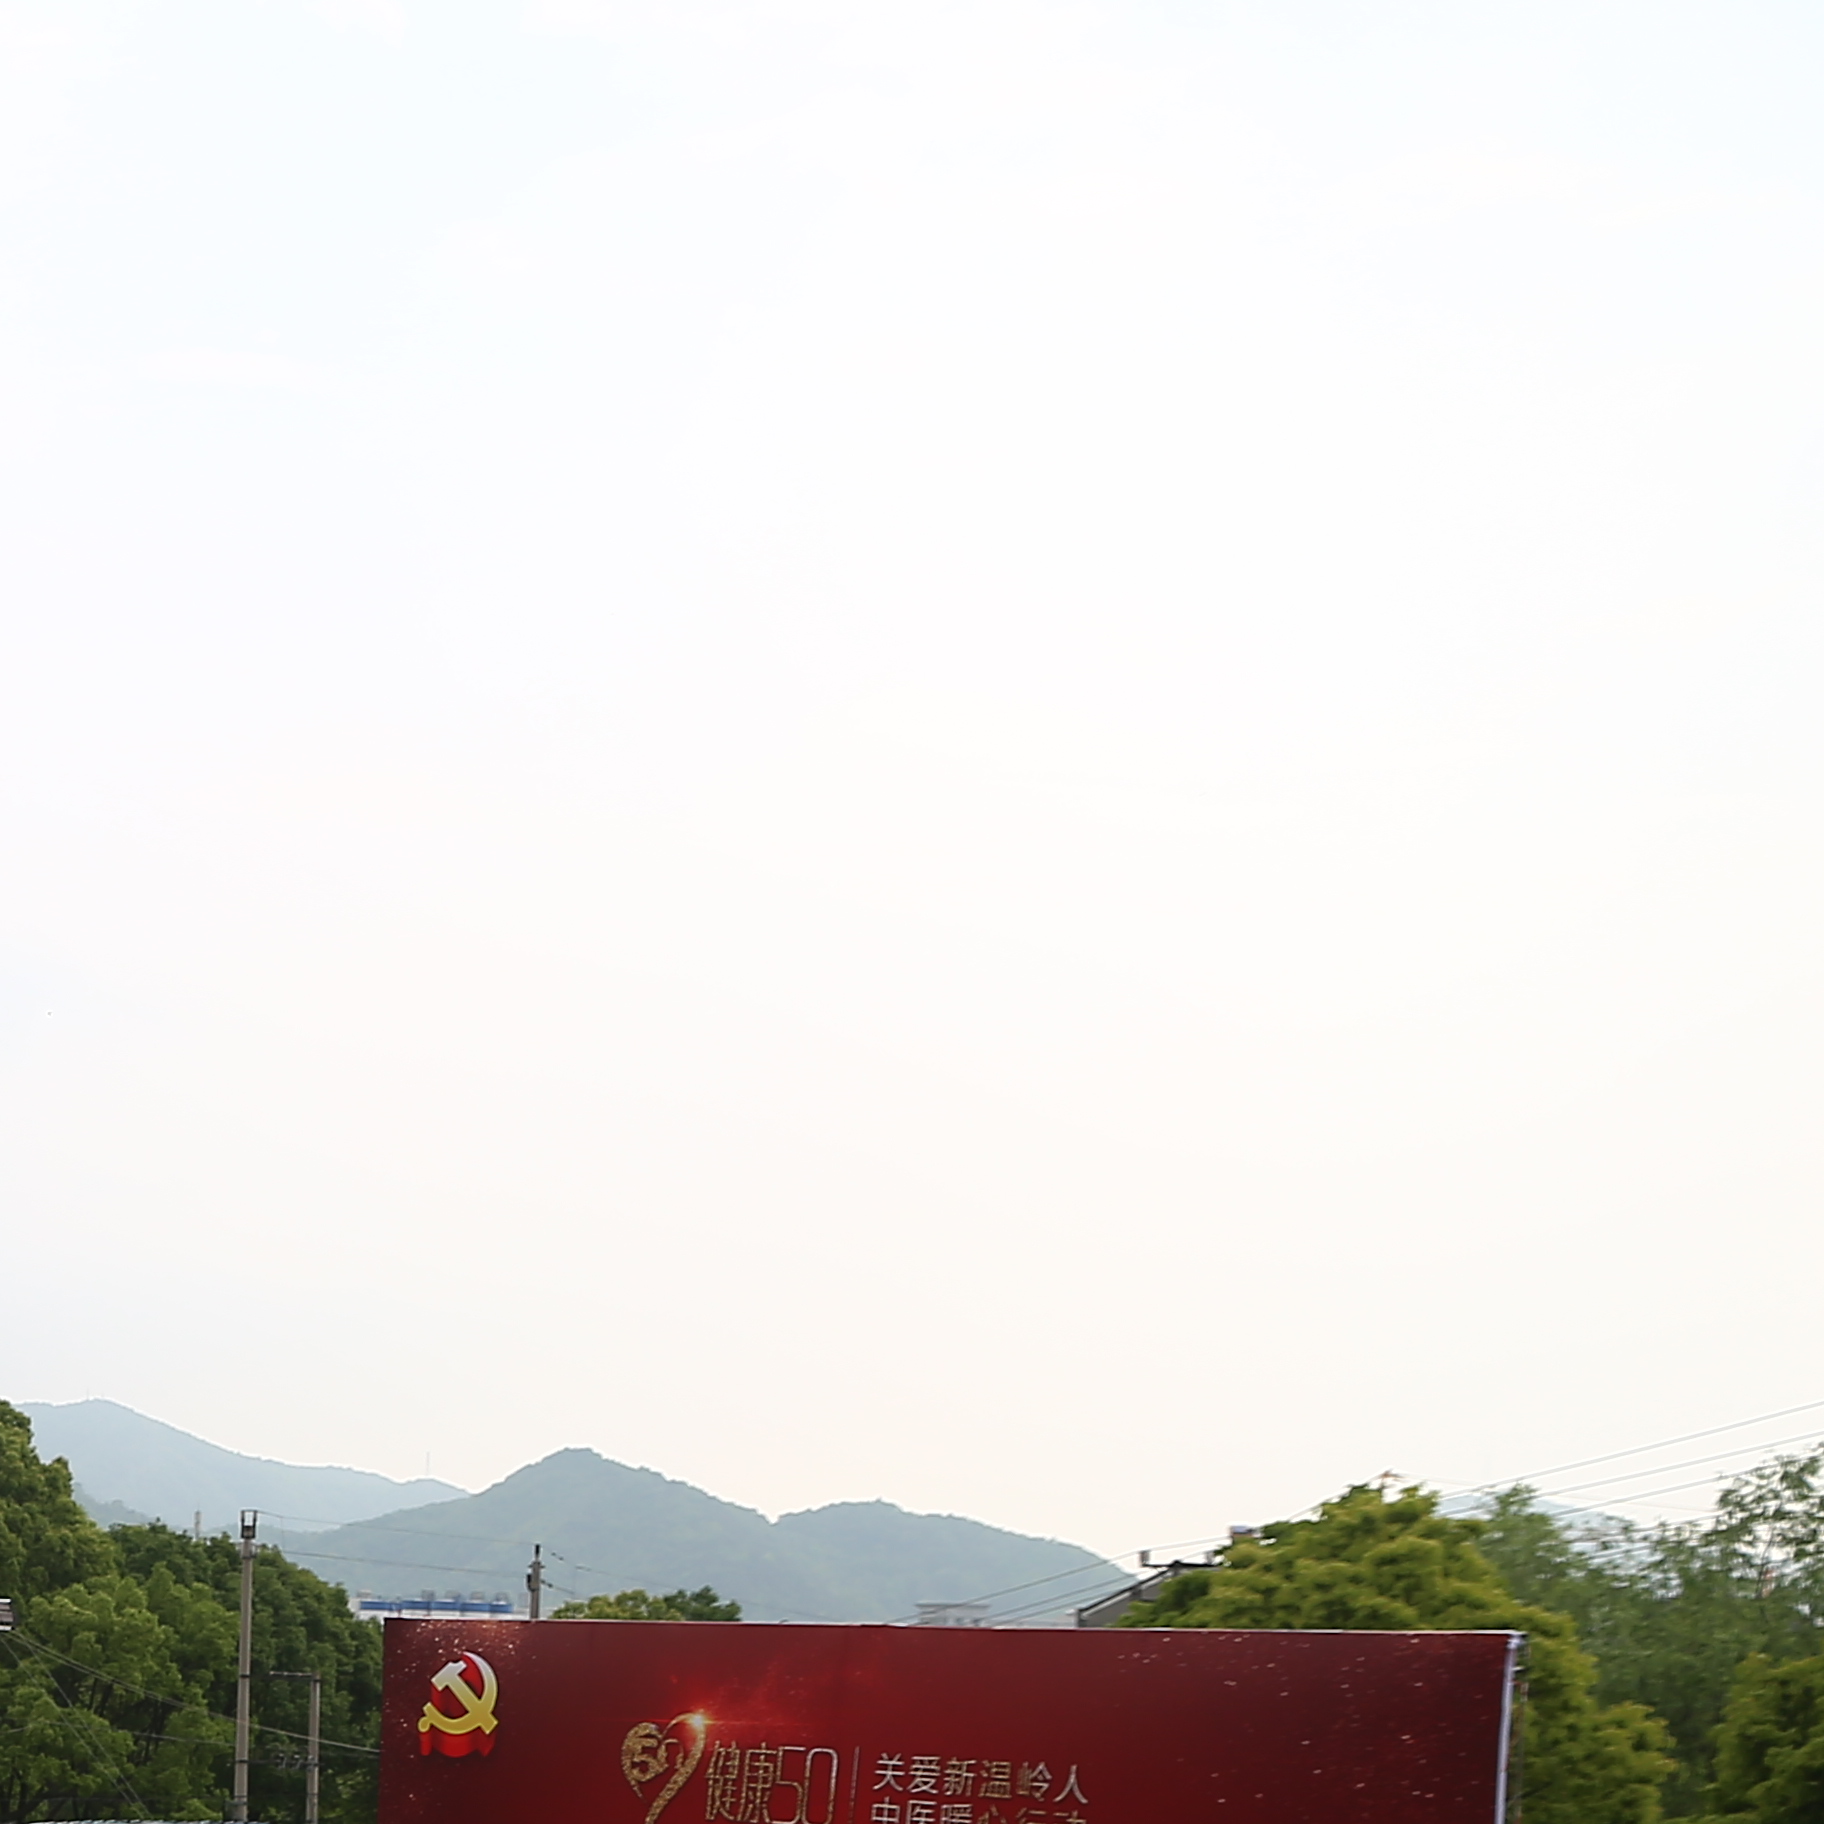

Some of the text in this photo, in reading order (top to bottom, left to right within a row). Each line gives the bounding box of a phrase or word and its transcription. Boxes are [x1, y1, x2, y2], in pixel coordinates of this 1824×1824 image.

[873, 1753, 1089, 1804] 关爱新温岭人
